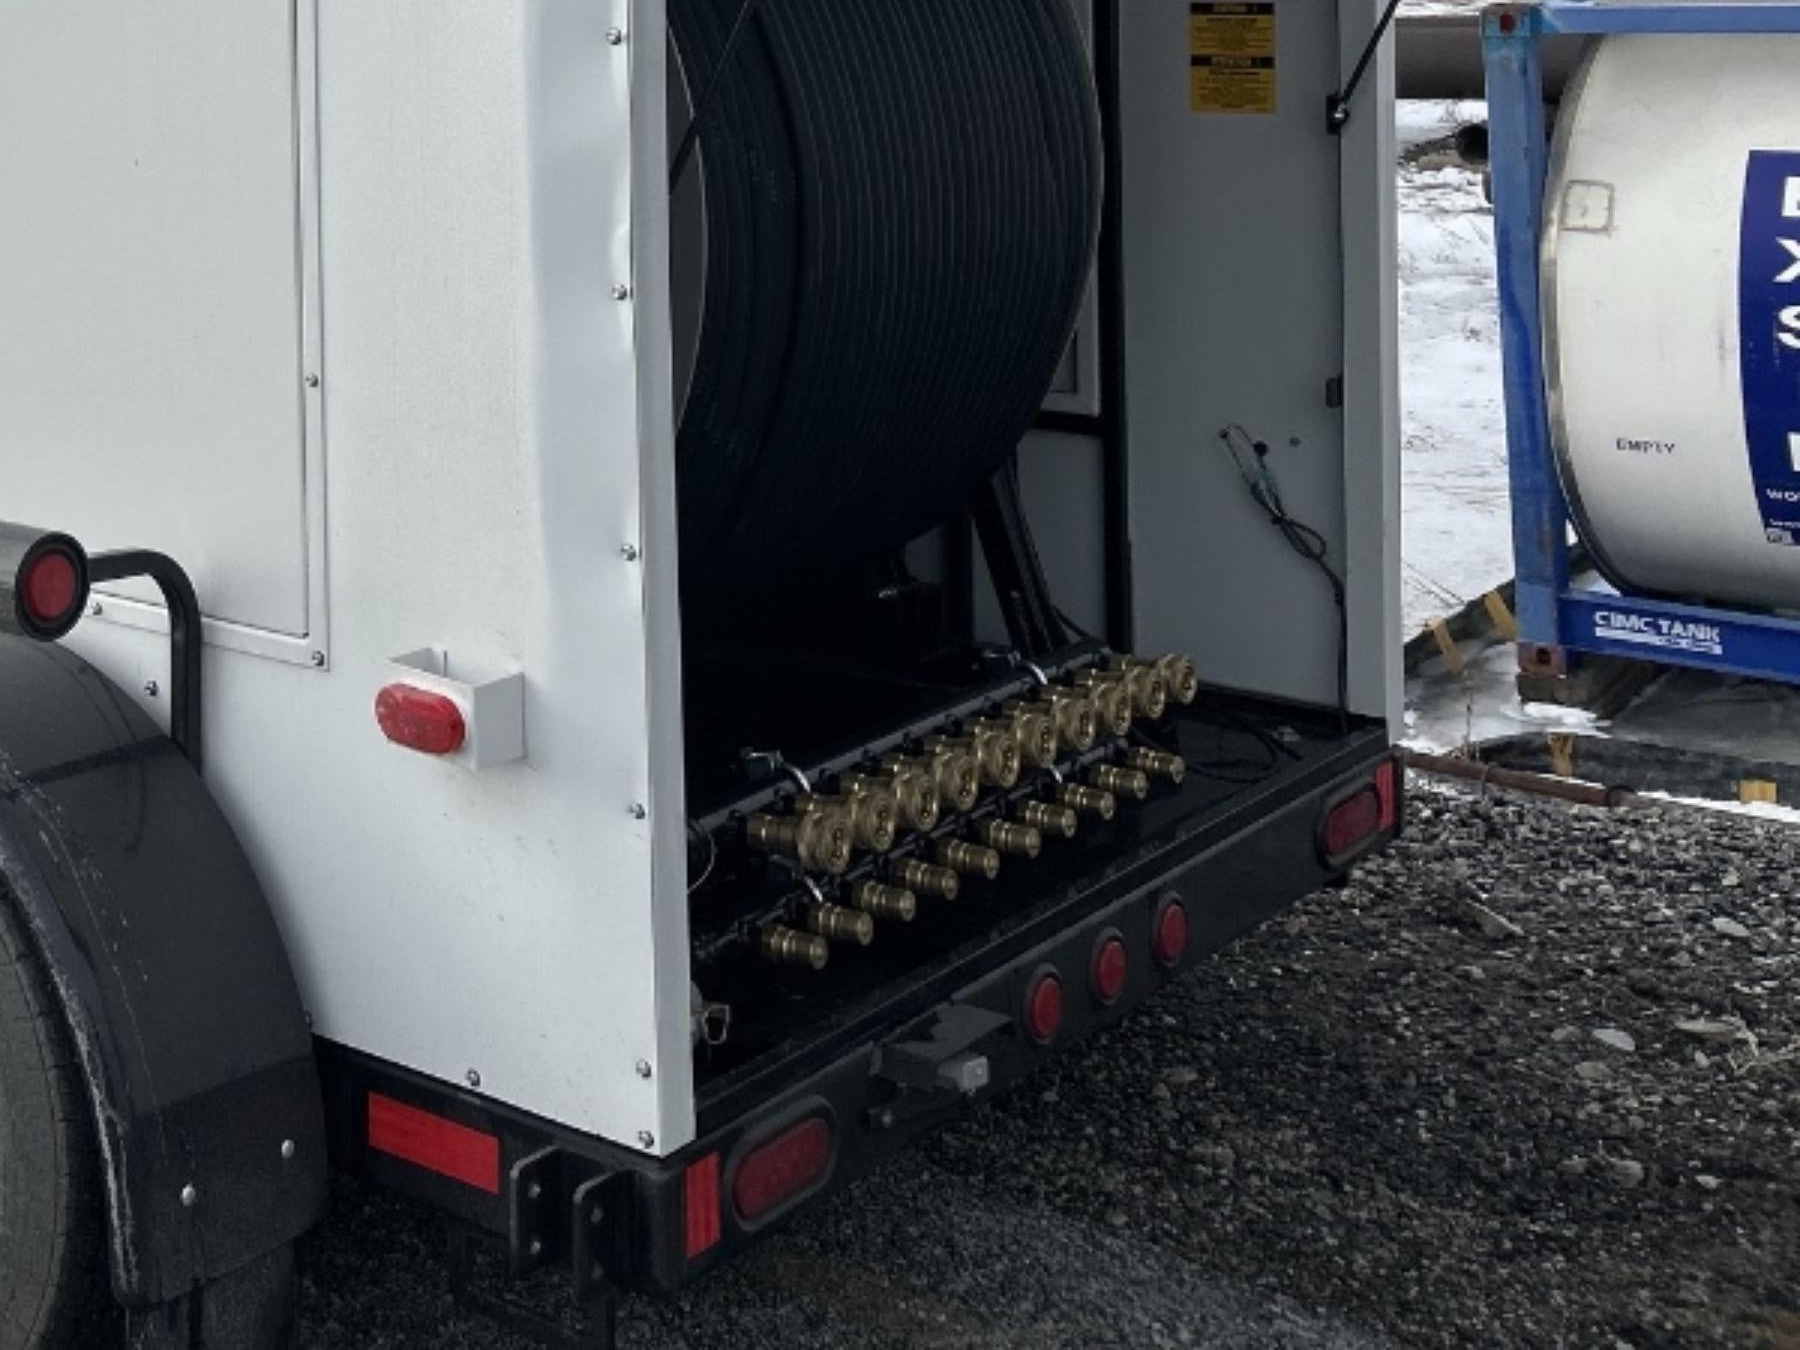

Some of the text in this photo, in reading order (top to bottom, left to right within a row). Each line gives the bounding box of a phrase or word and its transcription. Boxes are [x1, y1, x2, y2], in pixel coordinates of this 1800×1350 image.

[1616, 437, 1675, 454] EMPTY
[1593, 610, 1721, 644] CIMC TANK
